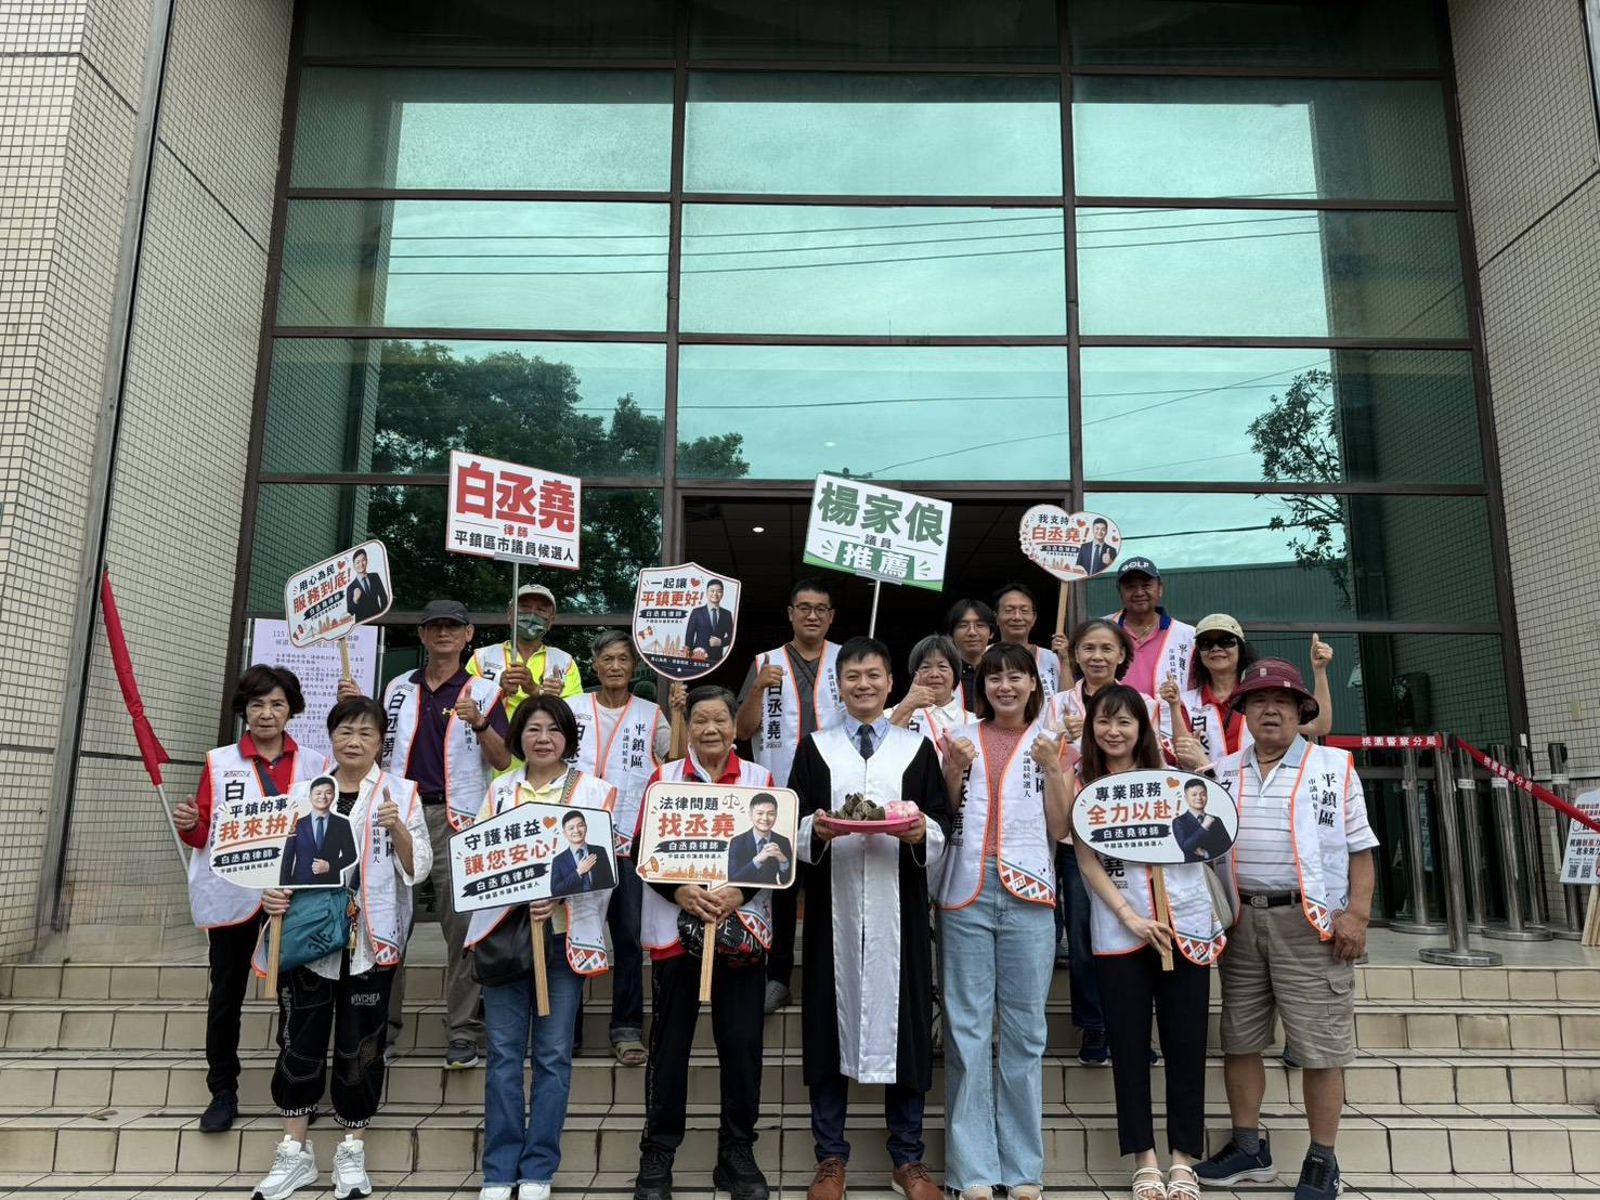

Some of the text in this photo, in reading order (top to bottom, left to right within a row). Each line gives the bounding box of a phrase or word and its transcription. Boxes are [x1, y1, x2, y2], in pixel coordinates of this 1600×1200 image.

[456, 461, 575, 533] 白丞堯
[817, 481, 943, 546] 楊家俍
[1038, 513, 1069, 526] 我支持
[503, 523, 529, 538] 律師
[864, 534, 892, 549] 議員
[454, 530, 574, 562] 平鎮區市議員候選人
[842, 543, 910, 577] 推薦
[1122, 561, 1149, 571] GOLF
[299, 564, 335, 592] 用心為民
[651, 577, 688, 589] 一起讓
[383, 692, 406, 757] 白丞堯
[631, 723, 646, 768] 平鎮區
[659, 796, 719, 810] 法律問題
[1095, 782, 1161, 801] 專業服務
[1319, 773, 1337, 827] 平鎮區
[229, 798, 288, 818] 平鎮的事
[1087, 800, 1181, 825] 全力以赴!
[464, 819, 541, 850] 守護權益
[658, 813, 735, 837] 找丞堯
[1103, 827, 1160, 839] 白丞堯律師
[221, 849, 273, 864] 白丞堯律師
[464, 837, 558, 876] 讓您安心!
[668, 841, 719, 851] 白丞堯律師
[476, 867, 535, 891] 白丞堯律師
